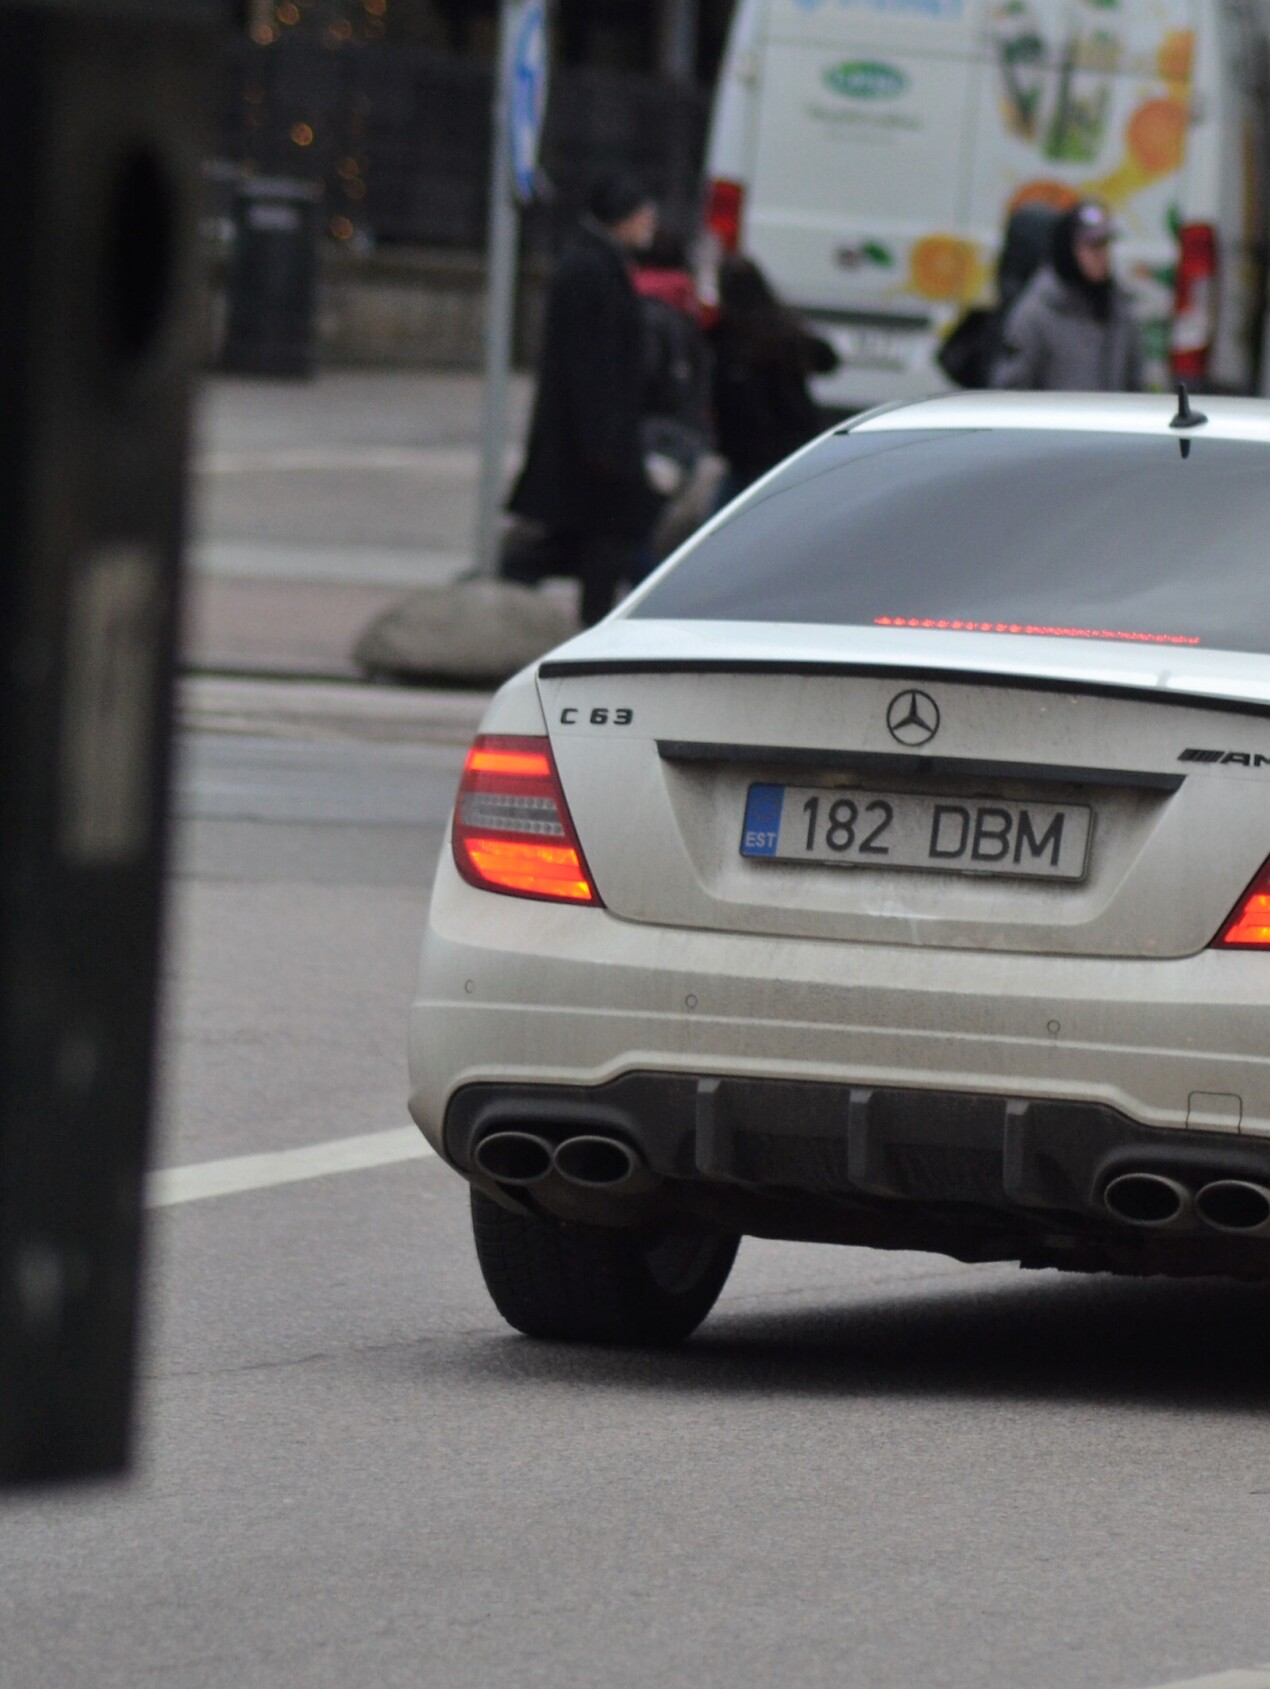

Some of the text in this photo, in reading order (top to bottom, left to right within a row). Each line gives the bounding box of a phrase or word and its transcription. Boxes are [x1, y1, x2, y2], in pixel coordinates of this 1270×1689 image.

[560, 707, 633, 726] C 63
[745, 832, 777, 848] EST
[803, 797, 1065, 866] 182 DBM
